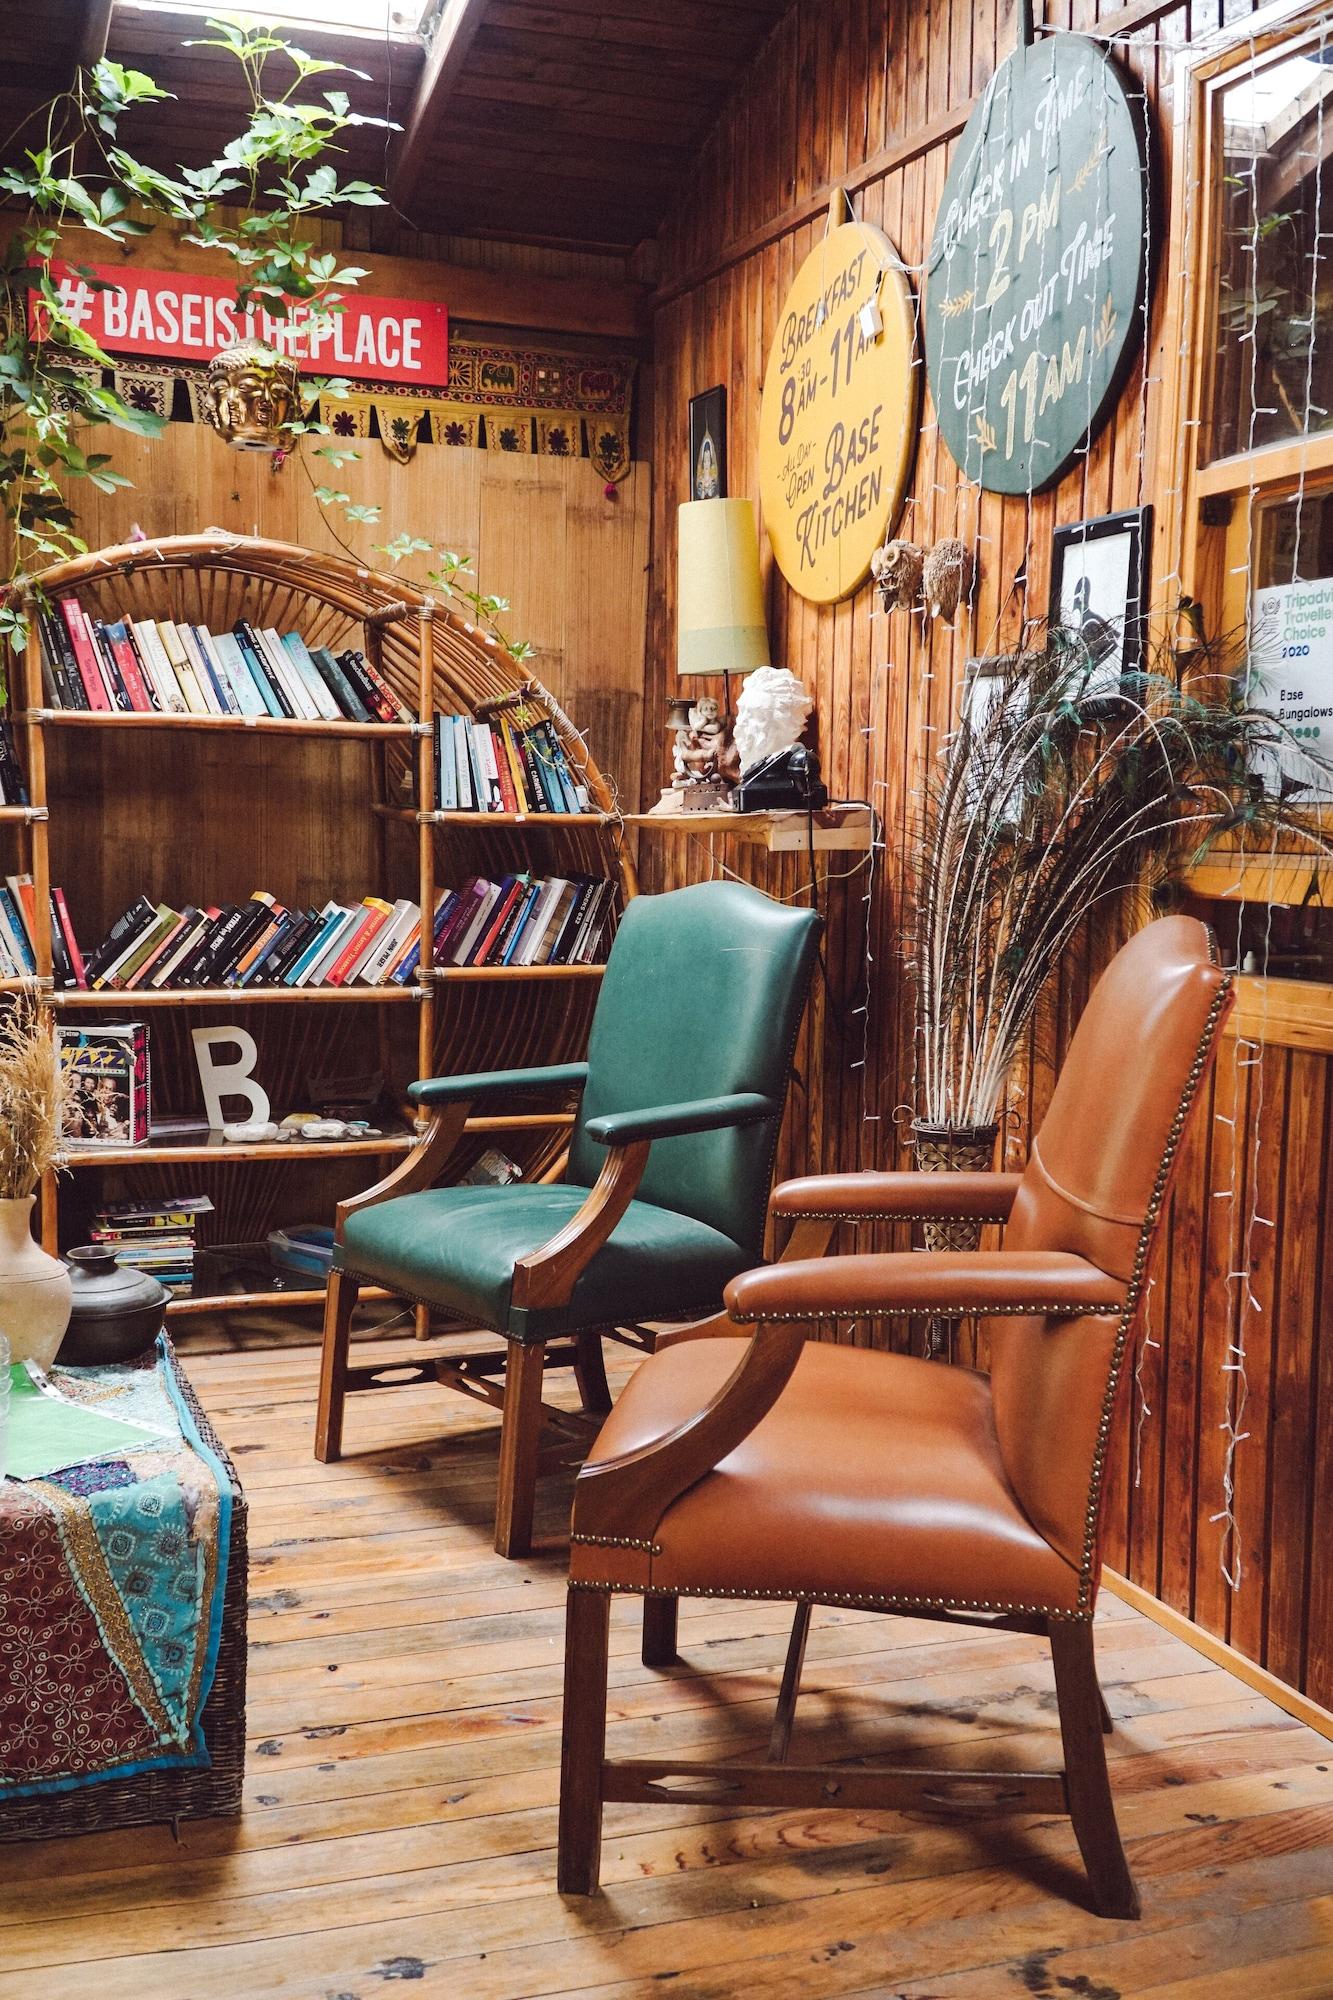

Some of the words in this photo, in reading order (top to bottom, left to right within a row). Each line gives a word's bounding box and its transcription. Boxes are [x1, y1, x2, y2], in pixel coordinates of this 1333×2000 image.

[944, 158, 1006, 261] CHECK
[1010, 129, 1031, 184] IN
[1035, 65, 1086, 158] TIME
[988, 208, 1013, 304] 2
[1018, 173, 1062, 263] PM
[780, 249, 867, 375] BREAKFAST
[953, 314, 1016, 411] CHECK
[1020, 271, 1059, 342] OUT
[1060, 213, 1116, 305] TIME
[786, 464, 815, 510] OPEN
[823, 404, 883, 501] BASE
[796, 465, 882, 572] KITCHEN
[1281, 644, 1310, 660] 2020
[1283, 626, 1326, 642] Choice
[1284, 606, 1333, 625] Travelle
[1279, 705, 1333, 722] Bungalows
[1280, 689, 1304, 702] Base
[192, 1026, 270, 1131] B
